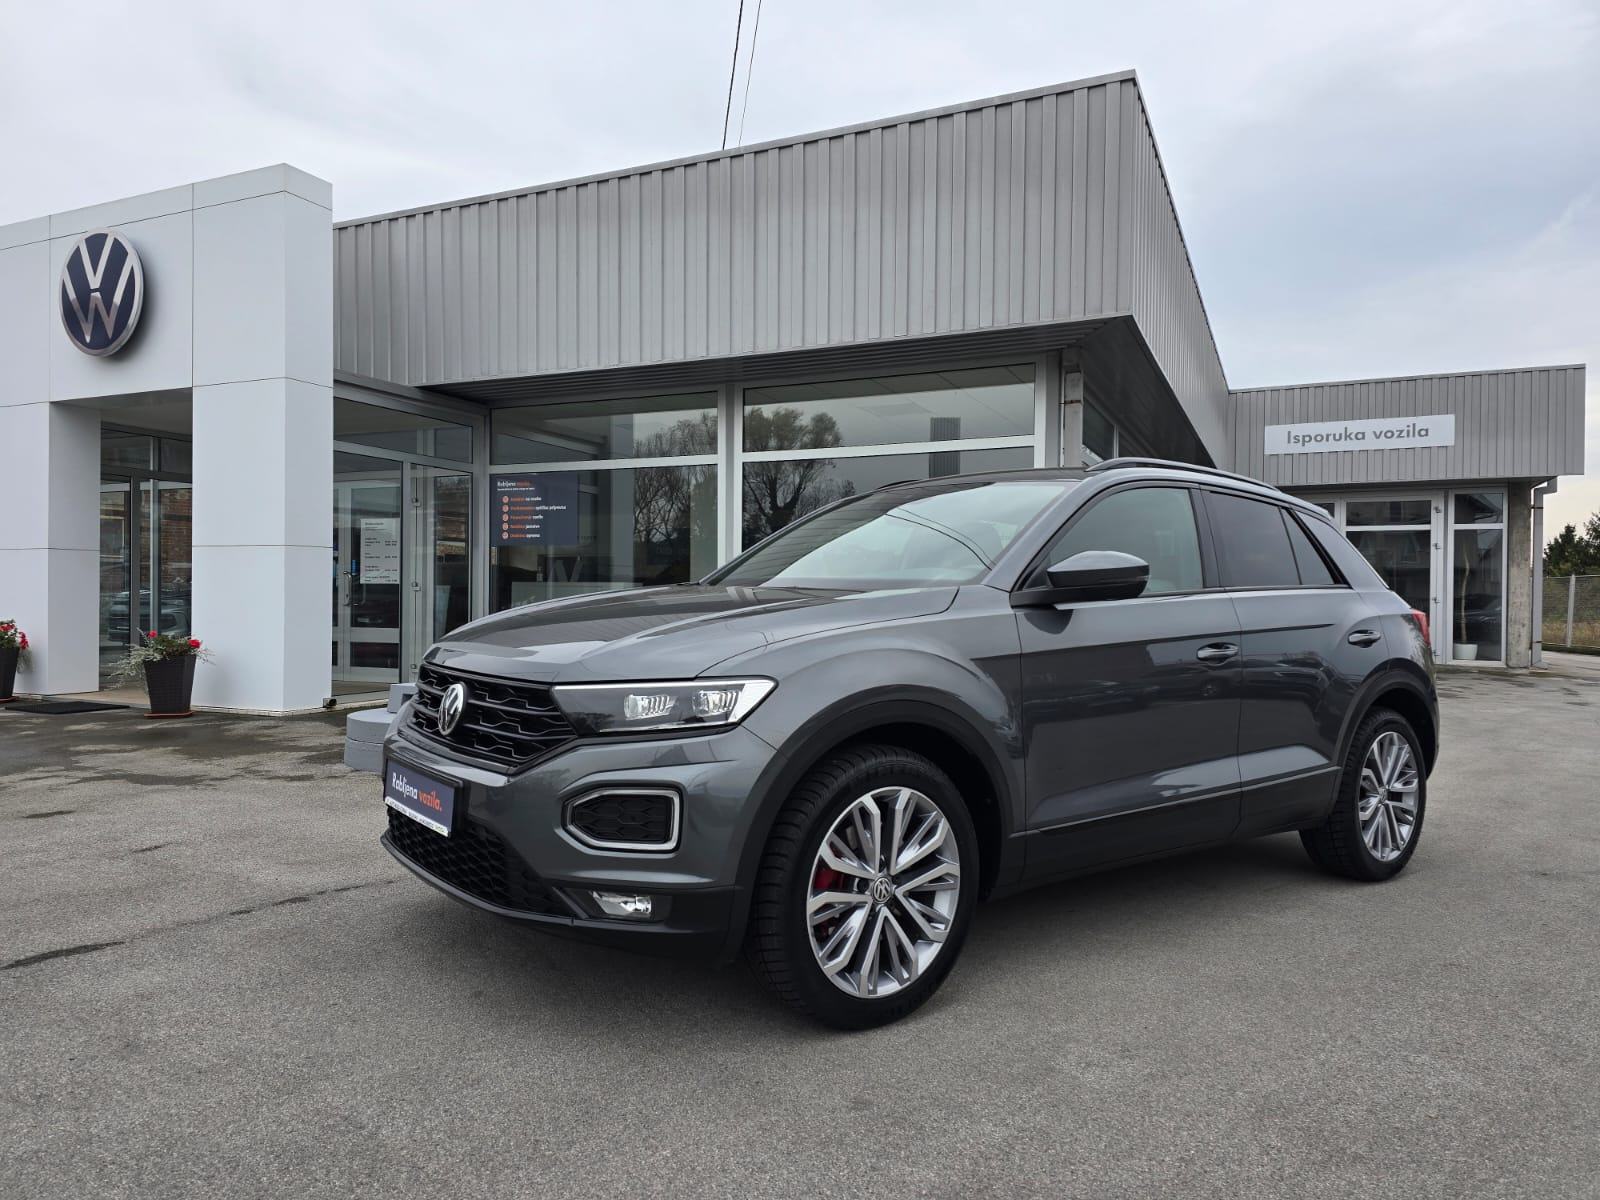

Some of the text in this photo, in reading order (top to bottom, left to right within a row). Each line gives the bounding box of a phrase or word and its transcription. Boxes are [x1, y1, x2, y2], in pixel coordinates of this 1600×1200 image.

[60, 229, 142, 353] VW
[1287, 422, 1430, 447] Isporuka vozila
[392, 771, 443, 812] Rabljena vozila.
